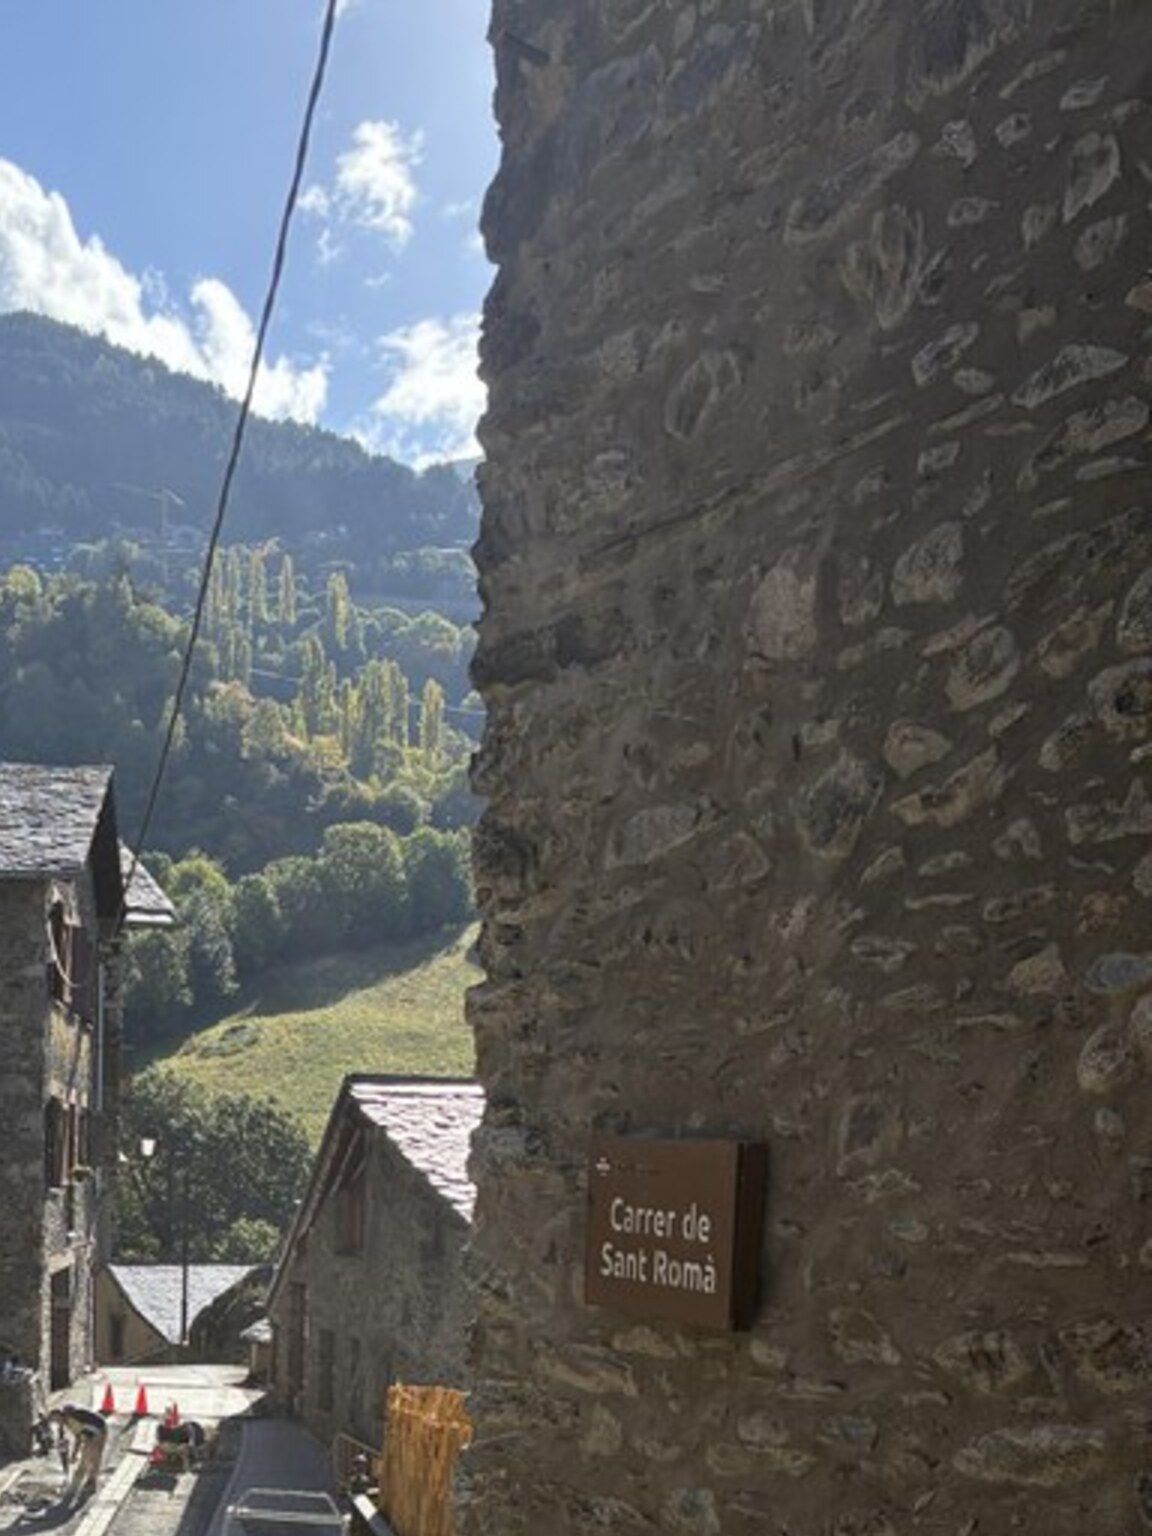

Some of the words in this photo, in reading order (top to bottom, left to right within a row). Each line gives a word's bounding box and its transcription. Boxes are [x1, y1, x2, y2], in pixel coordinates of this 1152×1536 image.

[610, 1197, 676, 1238] Carrer
[682, 1202, 711, 1243] de
[600, 1241, 647, 1282] Sant
[653, 1250, 716, 1293] Romà
